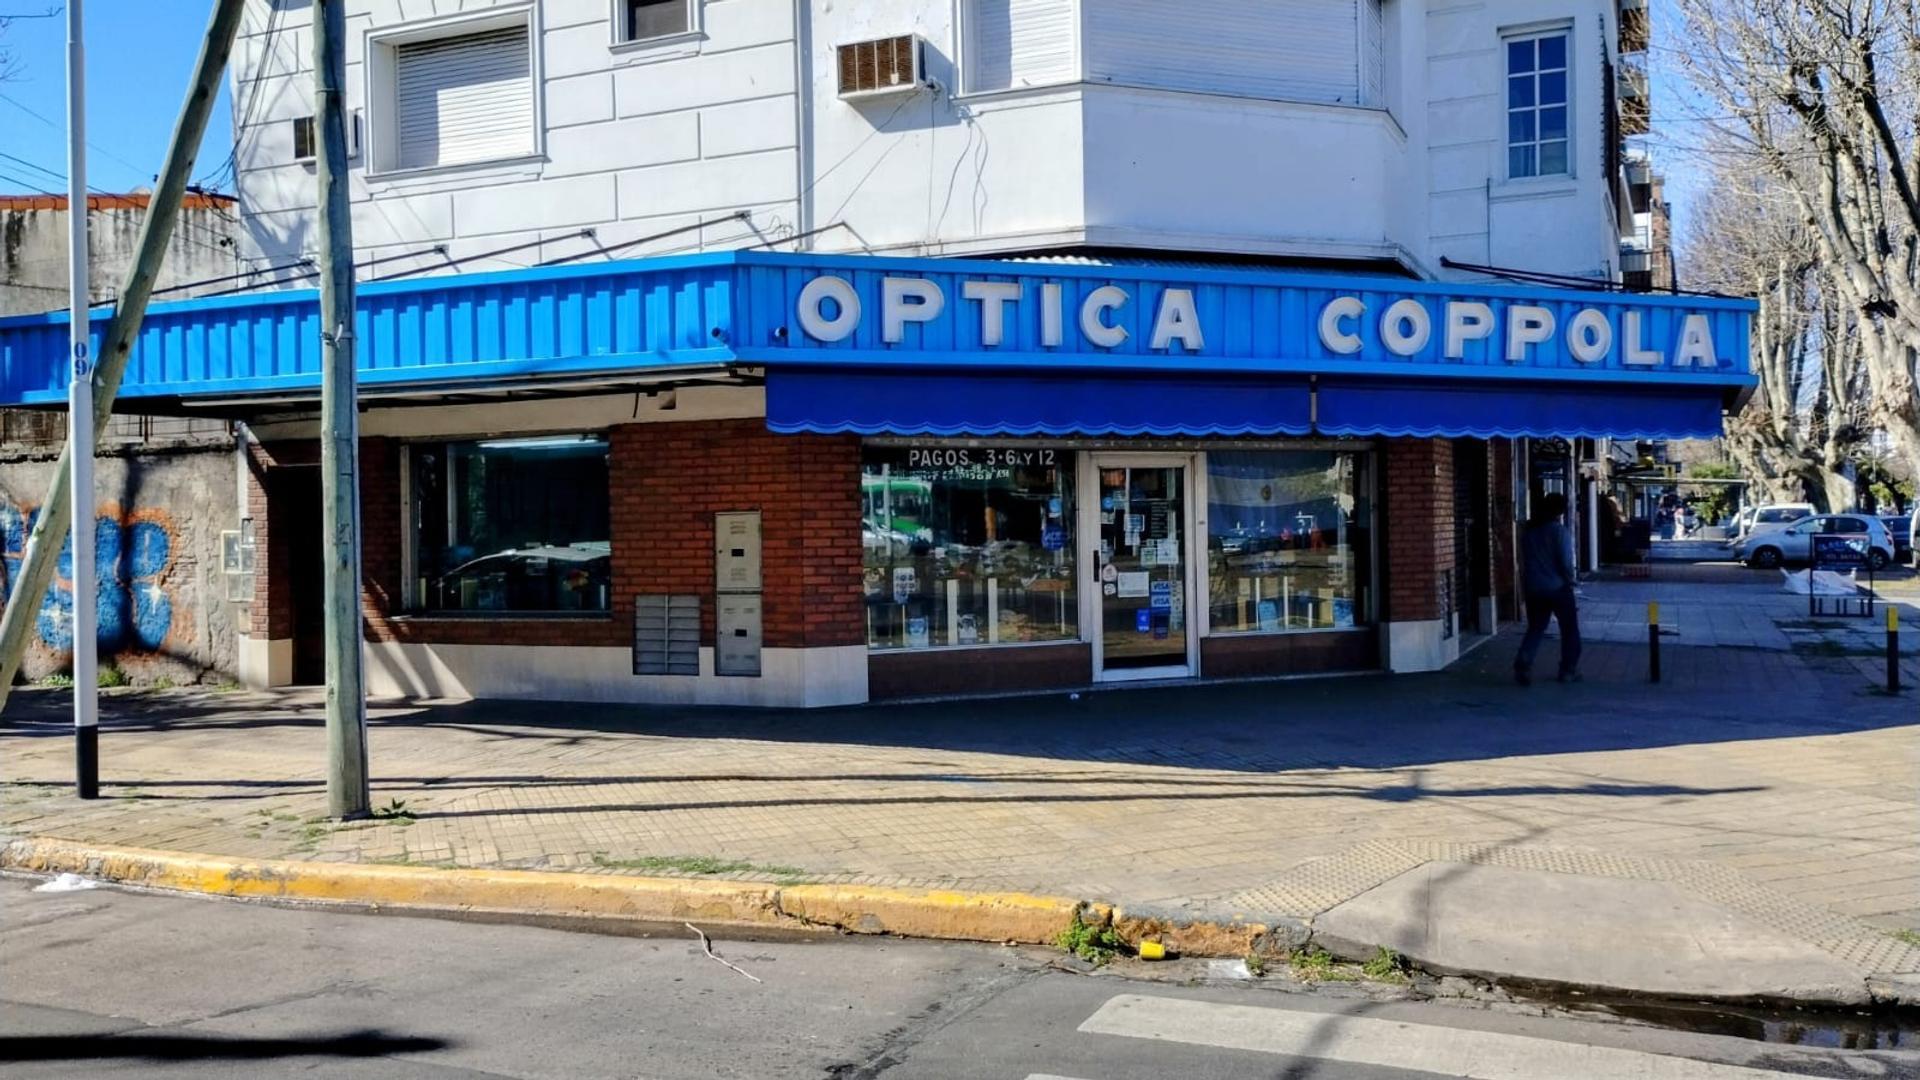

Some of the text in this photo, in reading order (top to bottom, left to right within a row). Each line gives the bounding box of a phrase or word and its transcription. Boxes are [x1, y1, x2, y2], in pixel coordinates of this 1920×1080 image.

[799, 276, 1718, 367] OPTICA COPPOLA
[909, 449, 969, 467] PAGOS
[1039, 449, 1055, 465] 12
